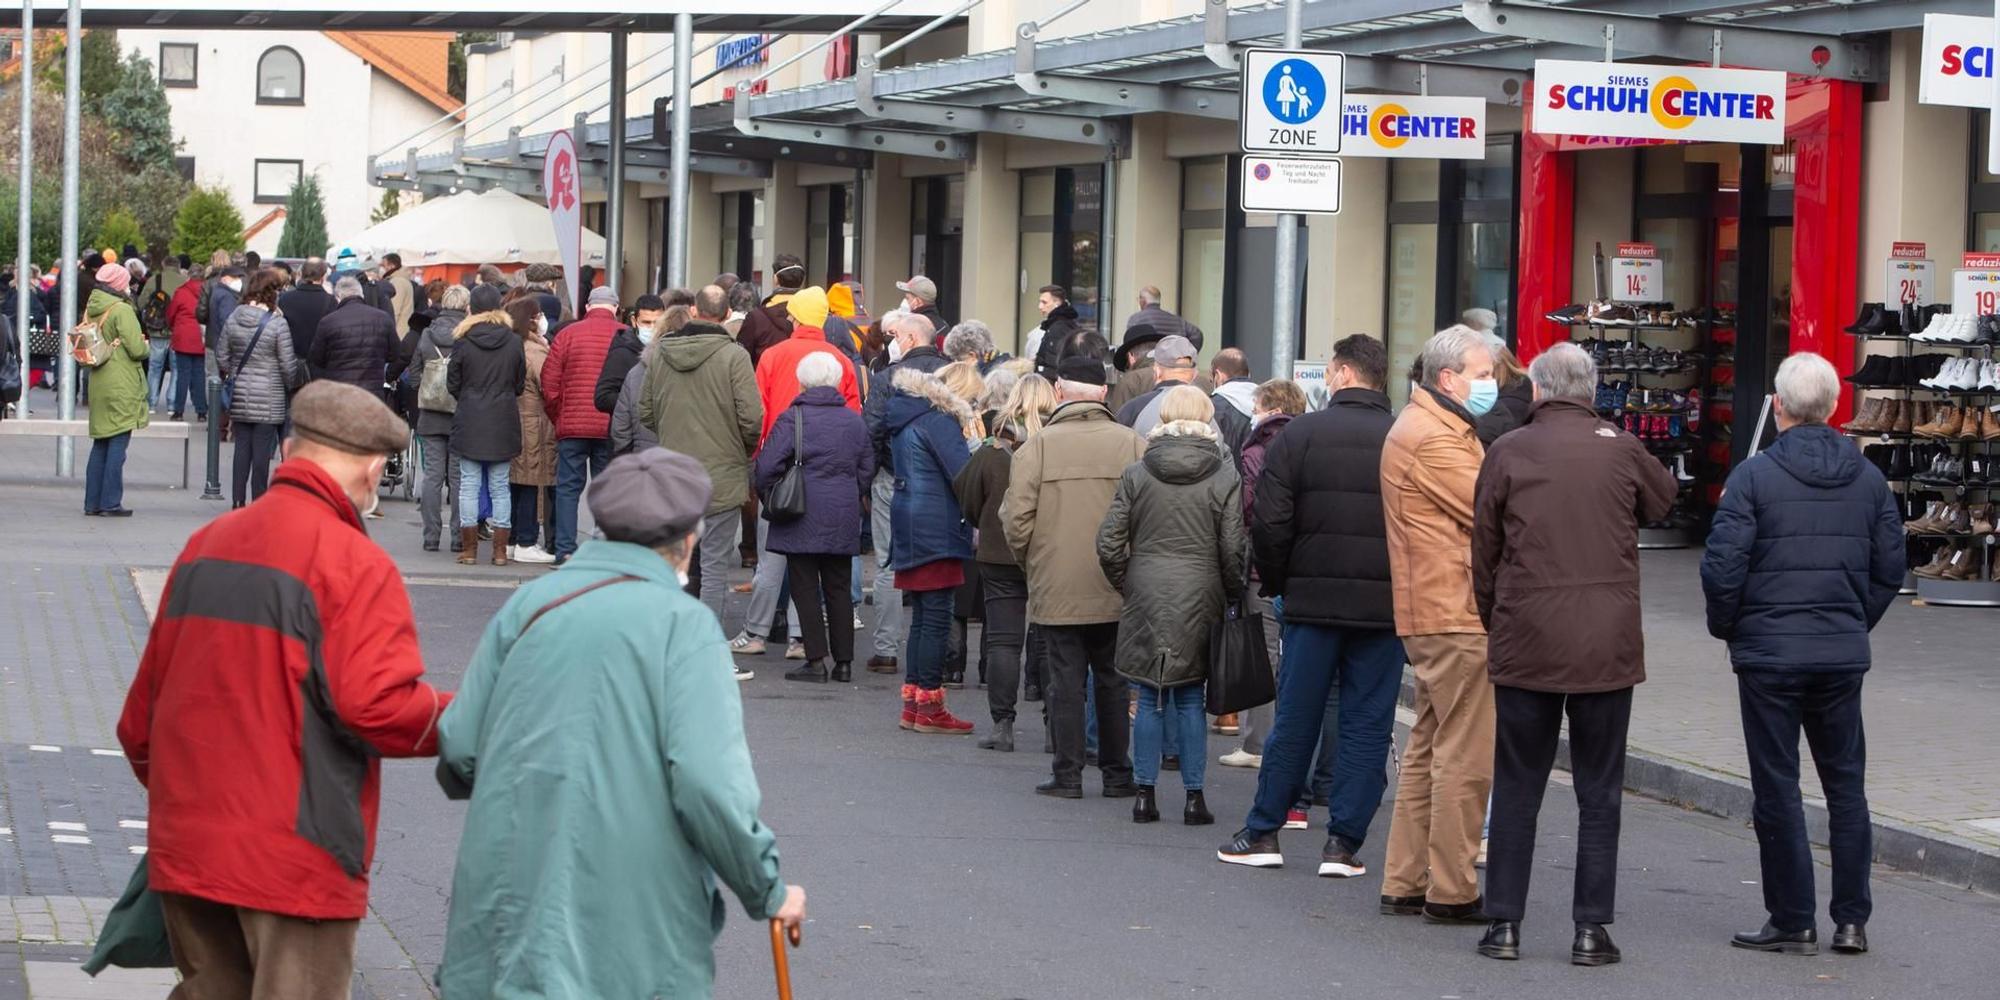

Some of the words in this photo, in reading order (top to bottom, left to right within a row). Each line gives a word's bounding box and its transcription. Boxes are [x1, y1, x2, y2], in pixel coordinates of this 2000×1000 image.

[1608, 75, 1649, 87] SIEMES
[1548, 84, 1648, 114] SCHUH
[1662, 89, 1775, 120] CENTER
[1269, 128, 1317, 146] ZONE
[1380, 114, 1477, 139] CENTER
[1620, 247, 1655, 256] reduziert
[1893, 247, 1925, 257] reduziert
[1626, 274, 1641, 296] 14
[1900, 279, 1916, 304] 24
[1975, 290, 1995, 317] 19
